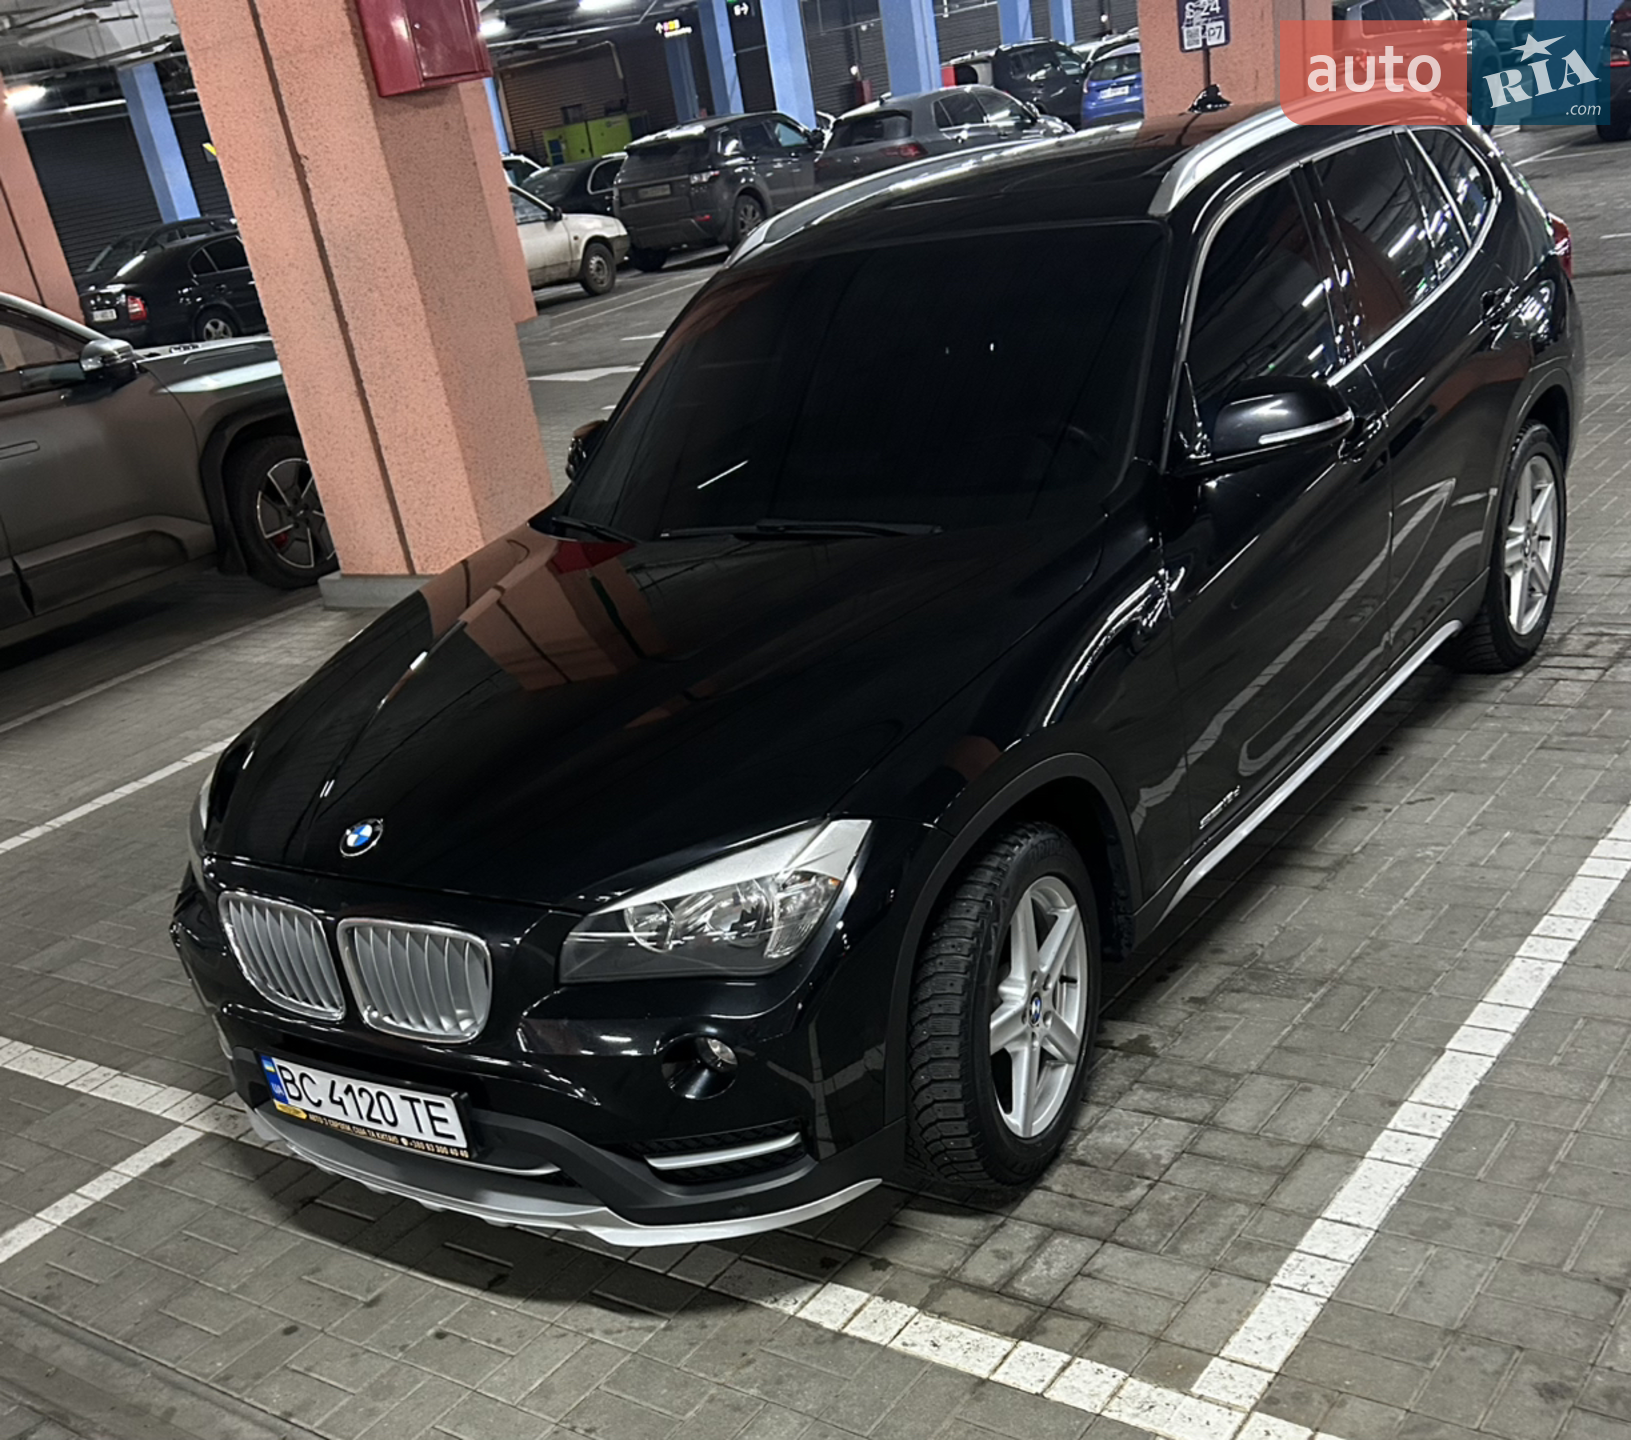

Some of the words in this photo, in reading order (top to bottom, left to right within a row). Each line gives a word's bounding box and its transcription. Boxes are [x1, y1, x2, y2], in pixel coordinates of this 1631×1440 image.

[277, 1064, 322, 1108] BC
[329, 1080, 398, 1127] 4120
[400, 1095, 456, 1140] TE
